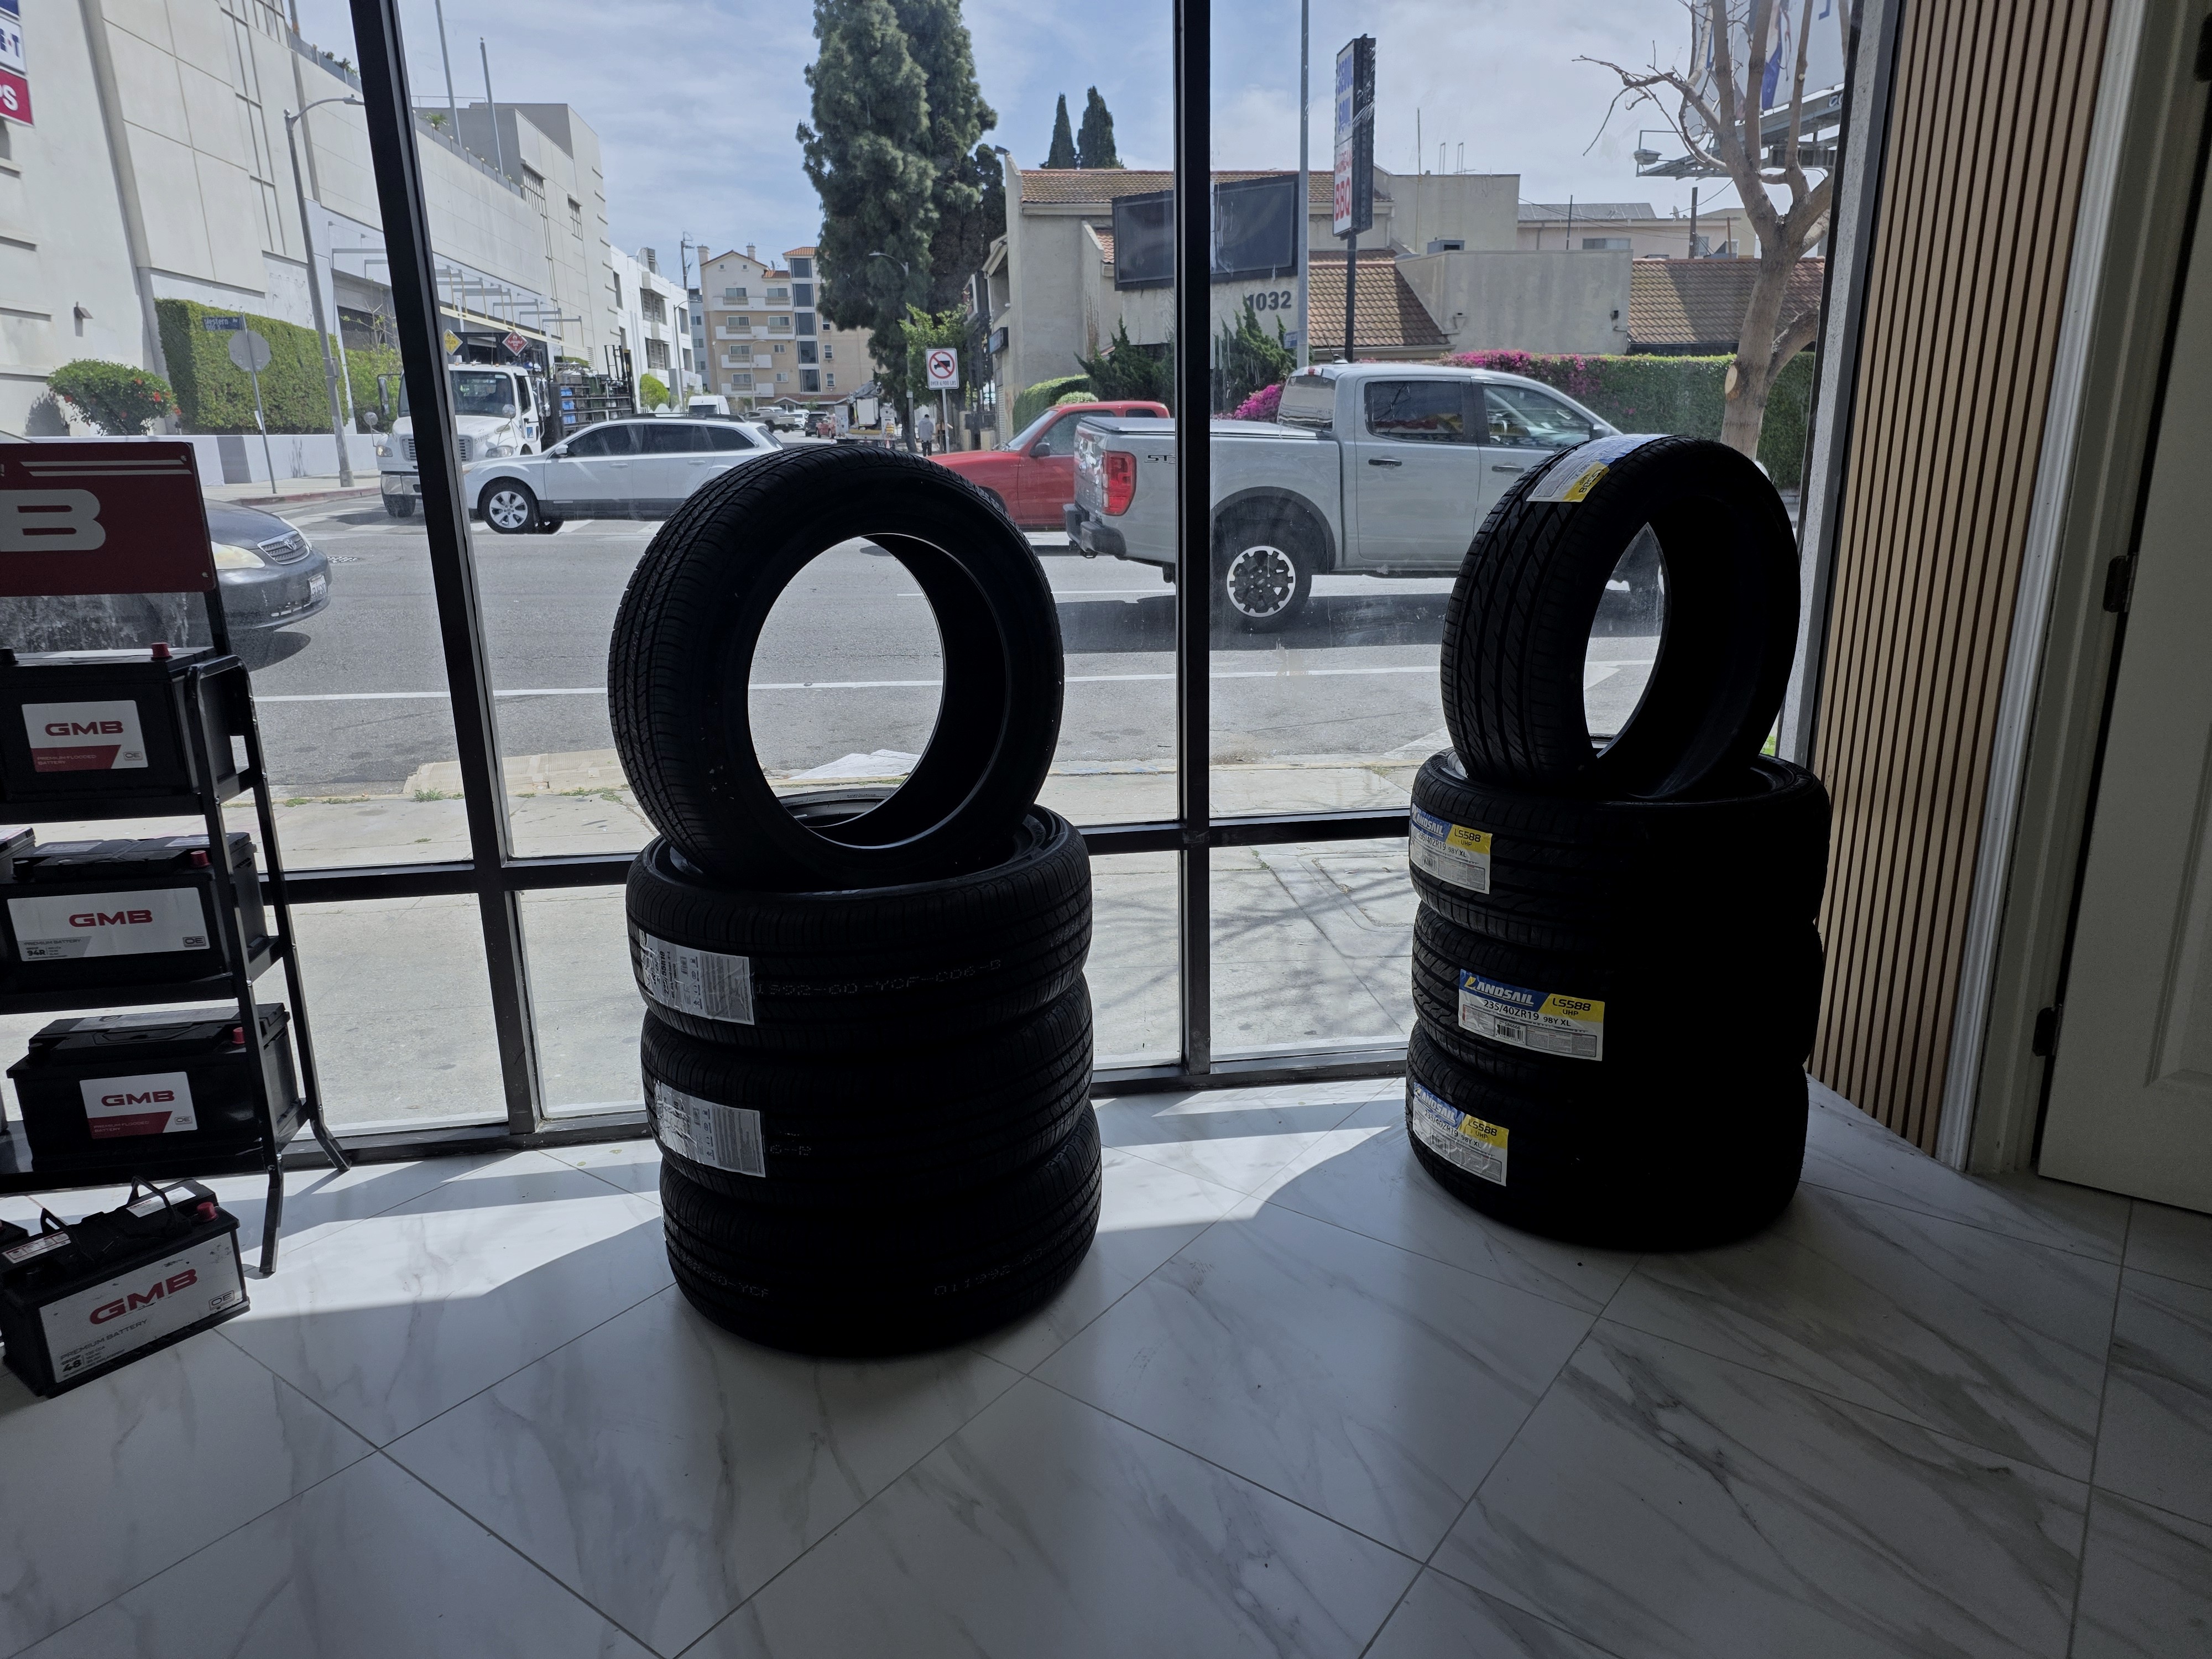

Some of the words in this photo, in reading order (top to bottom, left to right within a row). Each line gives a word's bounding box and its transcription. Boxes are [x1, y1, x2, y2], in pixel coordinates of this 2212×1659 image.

[1335, 177, 1350, 222] BBQ
[1245, 291, 1291, 311] 1032
[204, 317, 229, 327] Western
[45, 721, 123, 736] GMB
[1418, 831, 1446, 851] 235/40ZR19
[1454, 828, 1481, 842] LS588
[69, 910, 153, 927] GMB
[1464, 976, 1534, 1005] LANDSAIL
[1484, 999, 1540, 1021] 235/40ZR19
[1552, 997, 1592, 1012] LS588
[102, 1091, 175, 1107] GMB
[1424, 1109, 1458, 1137] 235/40ZR19
[1461, 1135, 1472, 1145] 98Y
[1473, 1140, 1481, 1149] XL
[1468, 1119, 1498, 1136] LS588
[1475, 1131, 1488, 1139] UHP
[90, 1269, 197, 1324] GMB
[211, 1293, 232, 1307] OE
[61, 1338, 105, 1359] PREMIUM
[107, 1319, 147, 1340] BATTERY
[62, 1359, 81, 1372] 48
